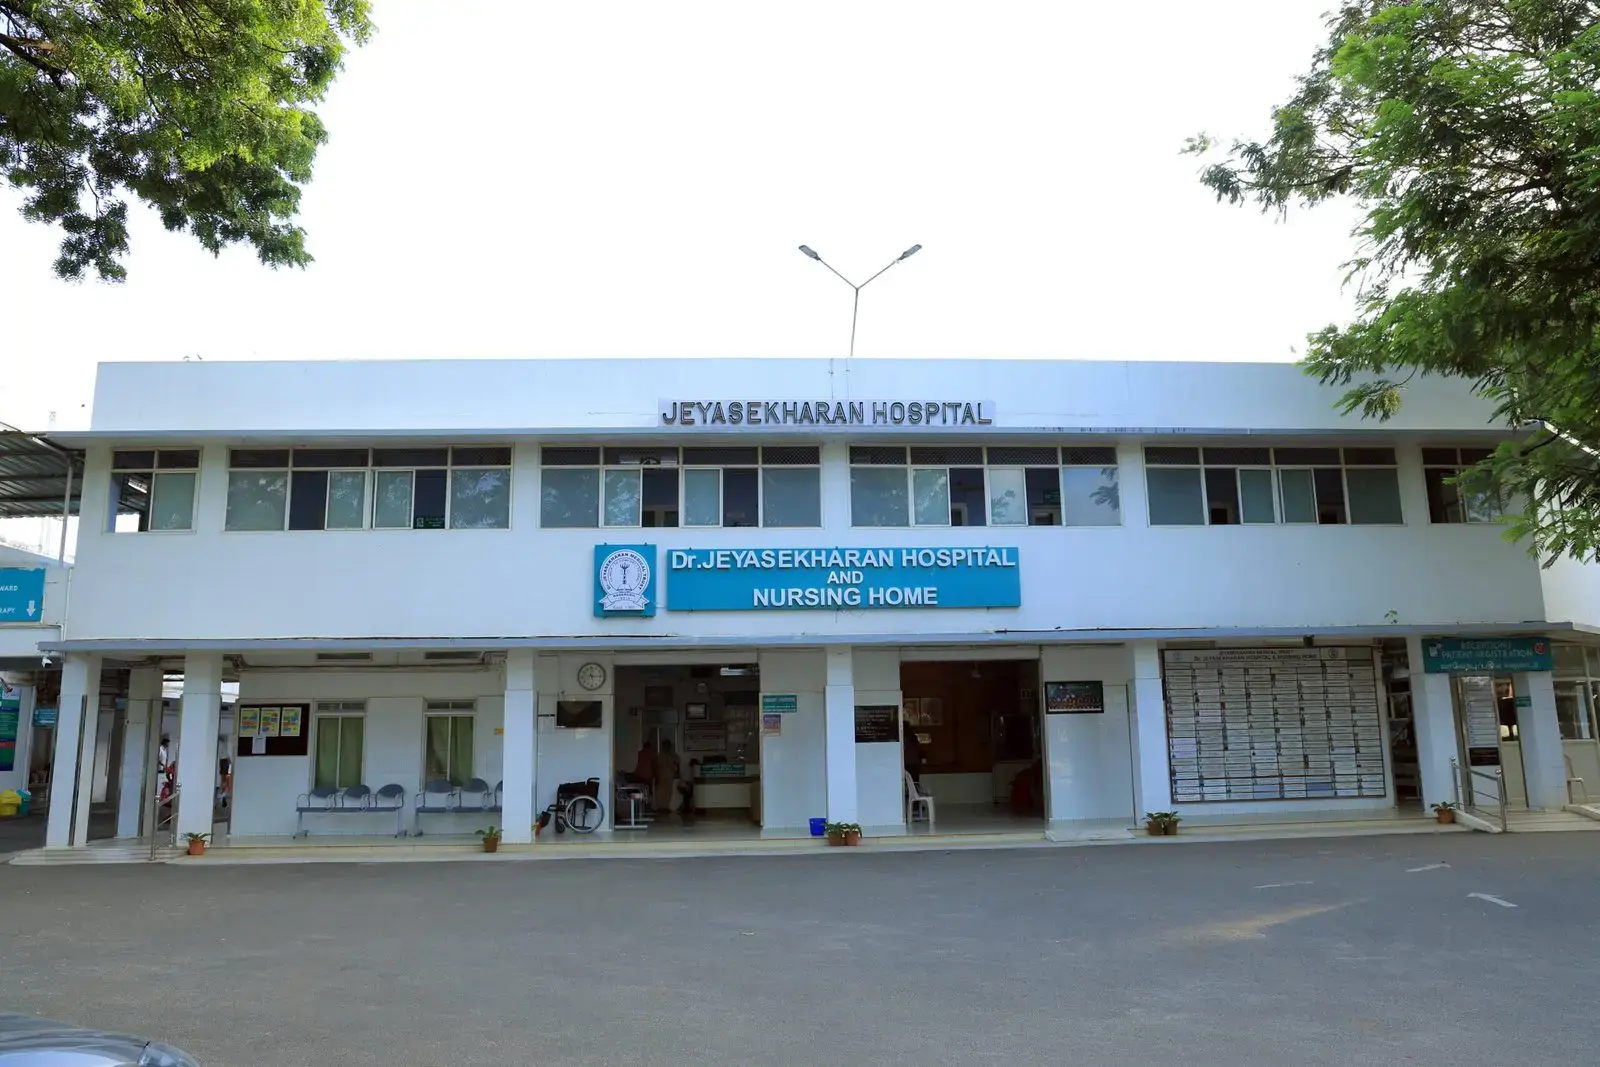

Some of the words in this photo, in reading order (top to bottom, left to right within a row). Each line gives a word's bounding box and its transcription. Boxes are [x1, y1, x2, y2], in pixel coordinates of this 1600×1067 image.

[662, 401, 864, 425] JEYASEKHARAN
[872, 401, 993, 425] HOSPITAL
[672, 550, 894, 569] Dr.JEYASEKHARAN
[902, 548, 1016, 568] HOSPITAL
[827, 570, 864, 584] AND
[753, 587, 861, 607] NURSING
[869, 586, 938, 606] HOME
[1474, 648, 1533, 659] GISTRATION
